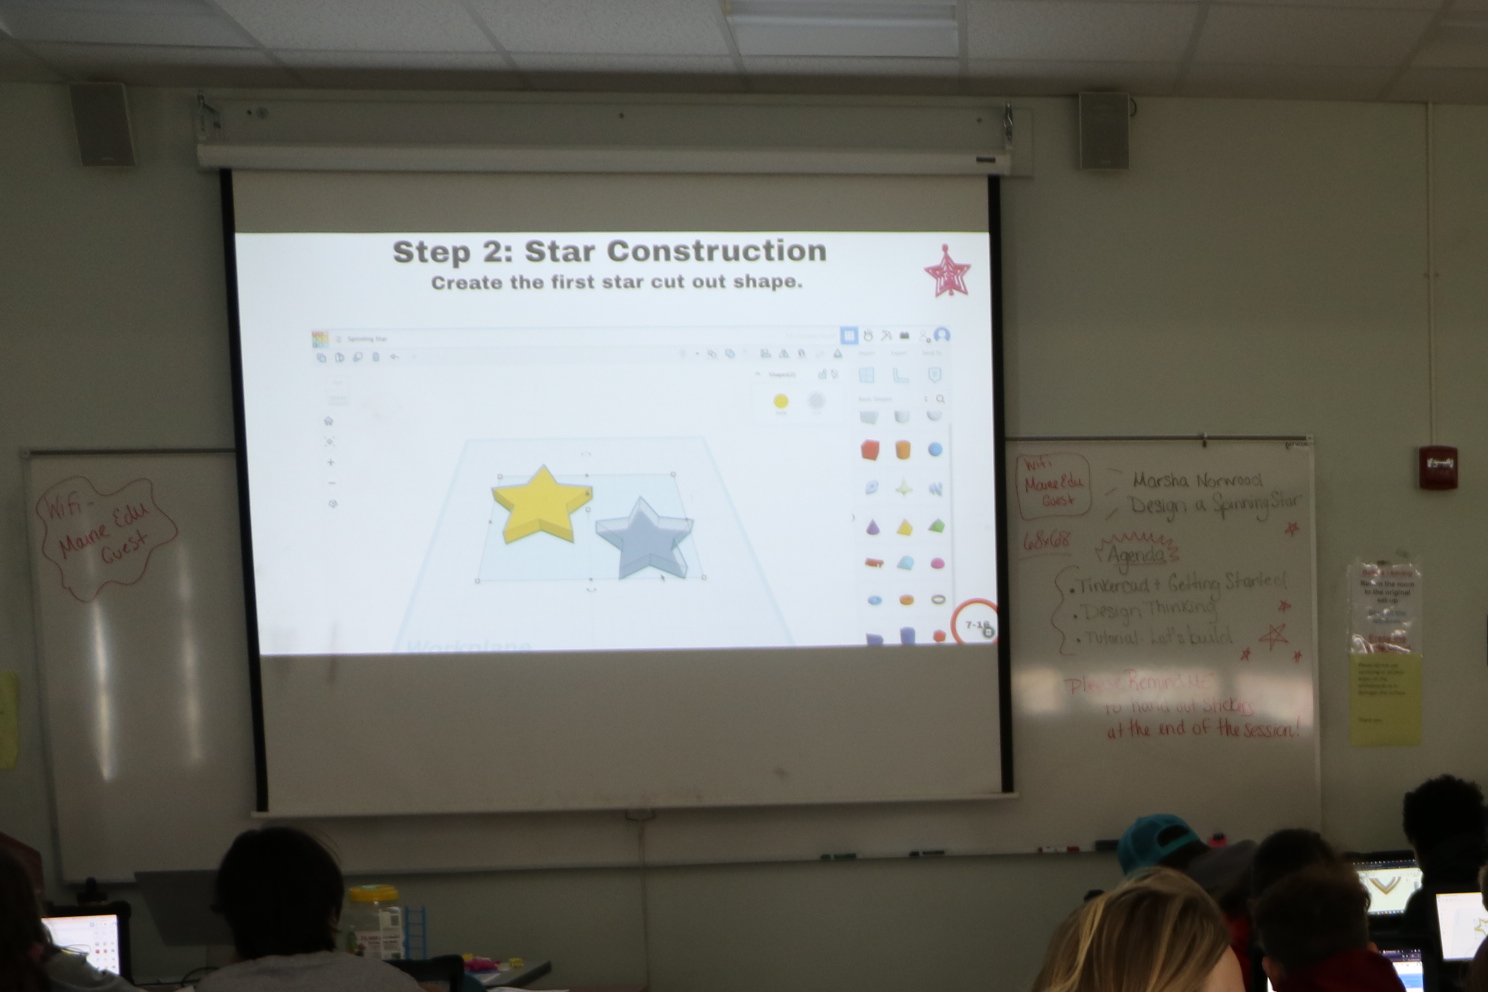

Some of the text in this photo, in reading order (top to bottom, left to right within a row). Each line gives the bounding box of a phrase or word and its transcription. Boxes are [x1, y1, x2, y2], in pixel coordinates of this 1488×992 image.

[393, 238, 827, 268] Step 2: Star Construction
[431, 274, 803, 292] Create the first star cut out shape.
[1133, 471, 1264, 488] Marsha Norwood
[1042, 494, 1075, 507] Guest
[1127, 489, 1302, 522] Design a Spinning Star
[58, 502, 150, 560] Maine Edu
[101, 529, 149, 565] Guest
[1108, 543, 1166, 576] Agenda
[1076, 576, 1150, 594] Tinkercad
[1168, 571, 1221, 601] Getting
[1225, 571, 1288, 591] Started
[1080, 598, 1220, 627] Design Thinking
[1107, 714, 1301, 739] at the end of the session!
